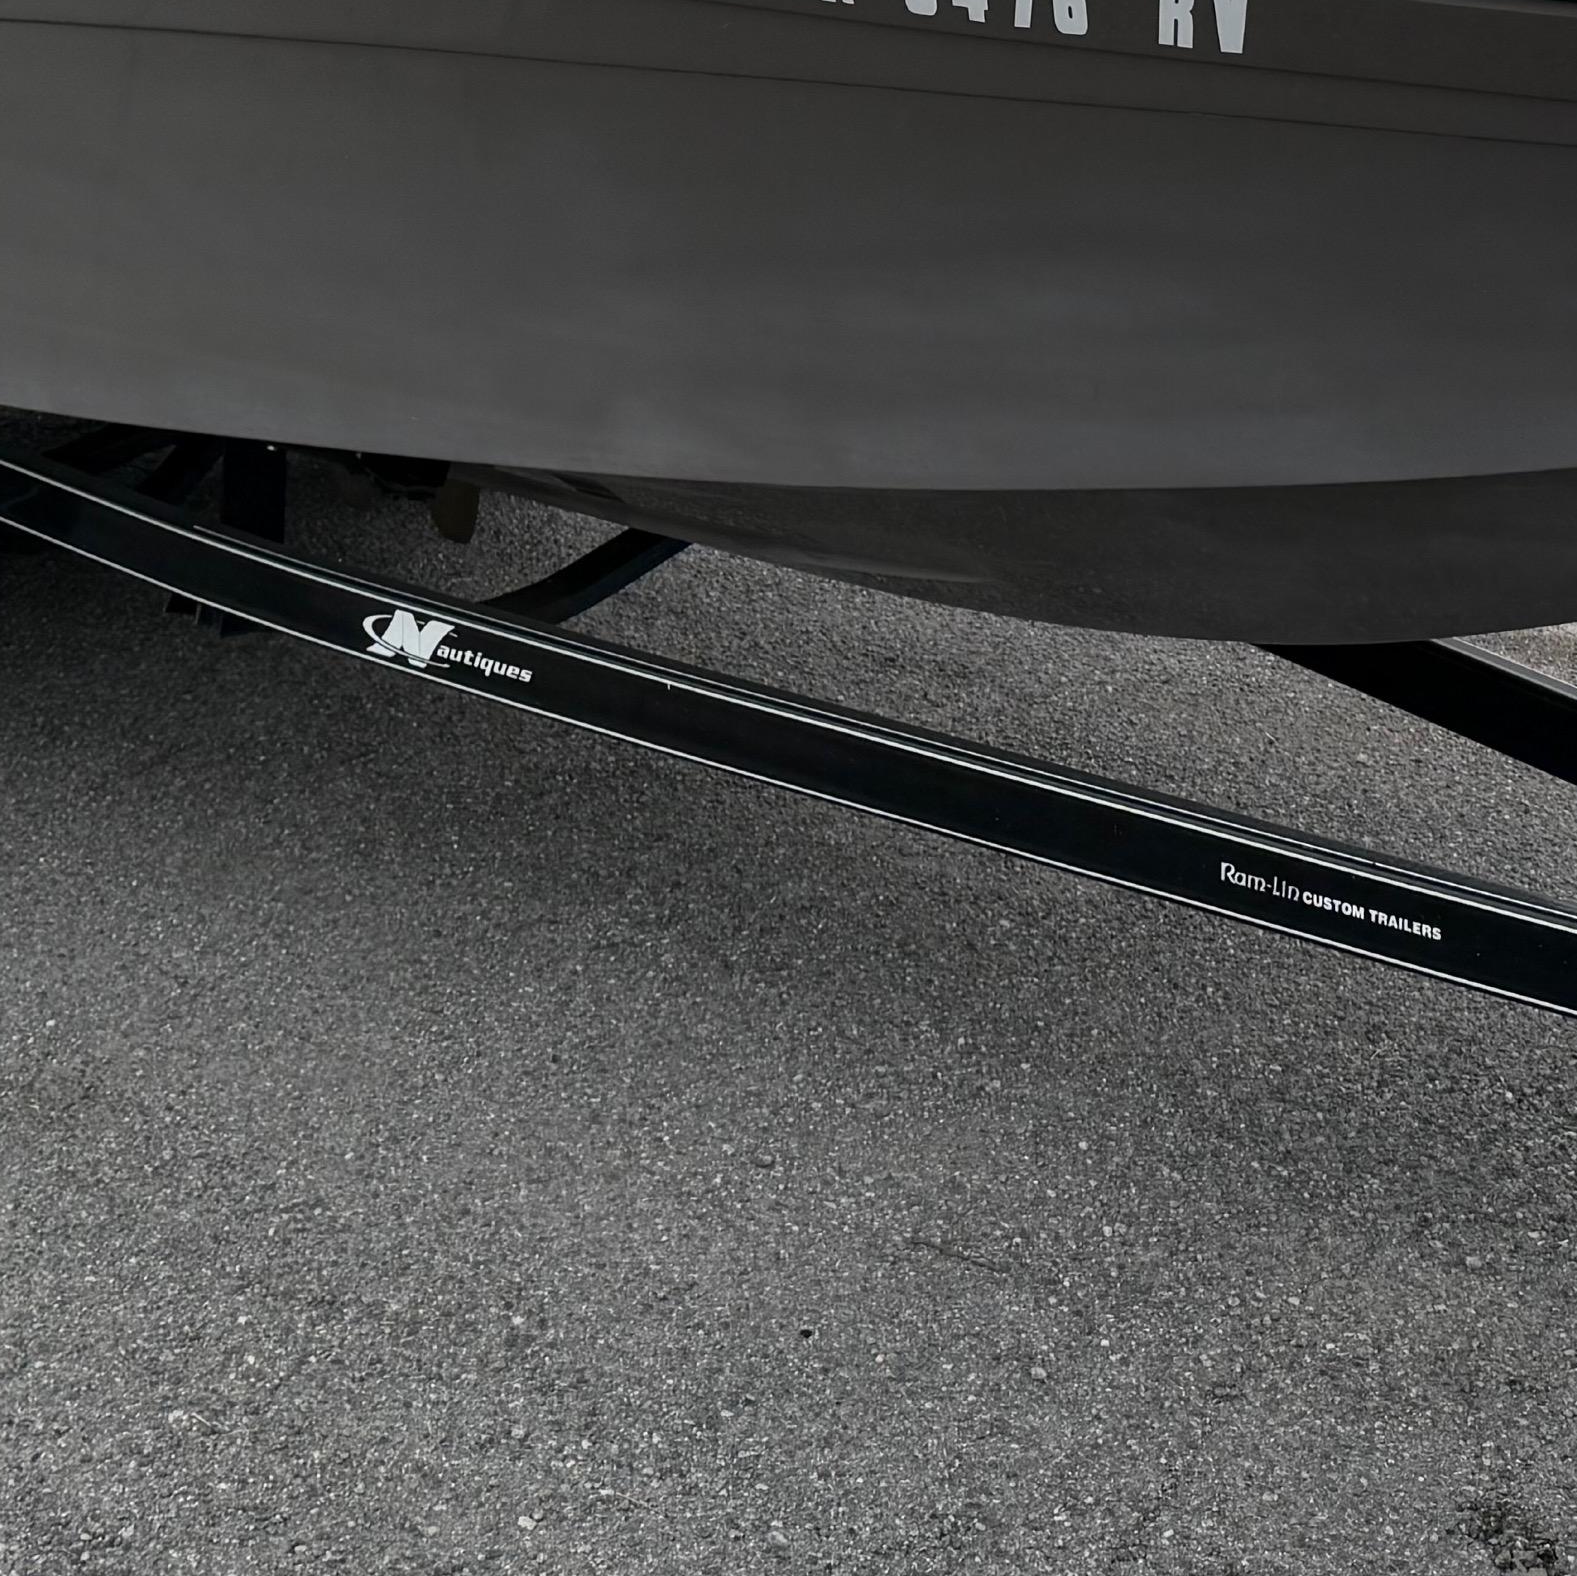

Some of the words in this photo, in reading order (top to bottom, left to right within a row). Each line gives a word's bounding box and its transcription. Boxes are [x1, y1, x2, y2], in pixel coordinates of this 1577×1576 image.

[363, 609, 533, 683] Nautiques
[1302, 890, 1365, 920] CUSTOM
[1368, 909, 1442, 941] TRAILERS
